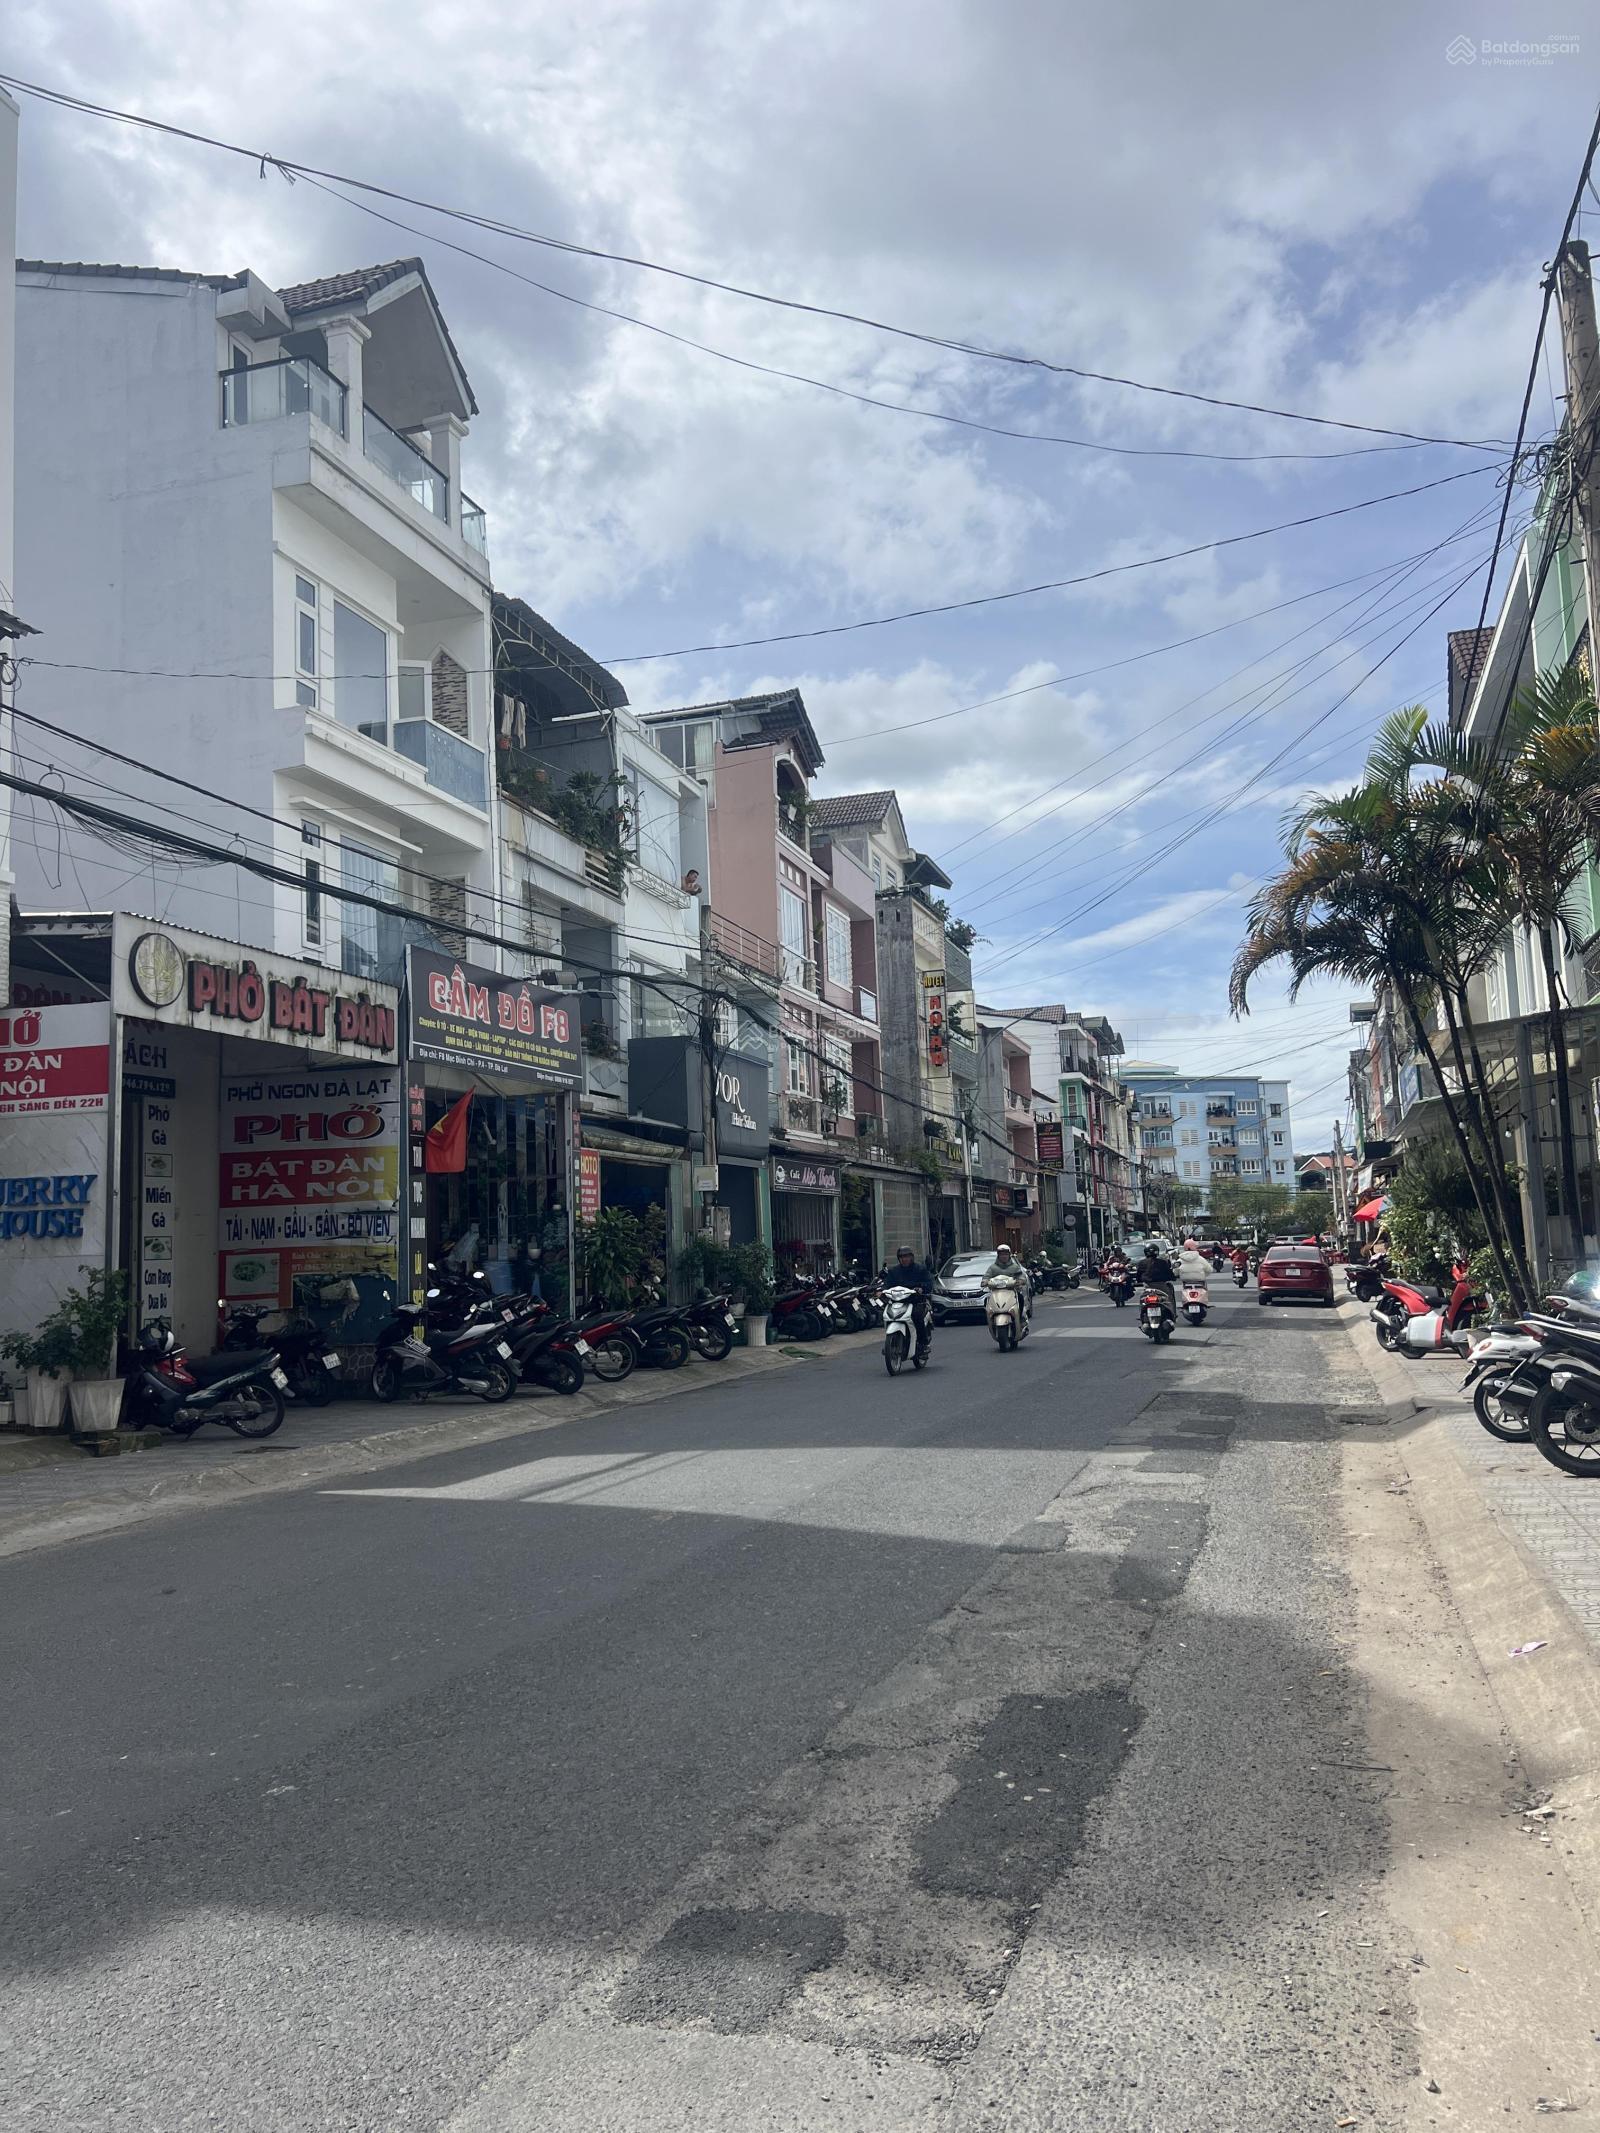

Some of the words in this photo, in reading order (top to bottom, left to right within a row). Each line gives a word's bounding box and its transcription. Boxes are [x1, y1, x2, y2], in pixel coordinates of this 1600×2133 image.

[923, 975, 944, 988] HOTEL
[188, 960, 265, 1022] PHỞ
[269, 976, 330, 1037] BÁT
[334, 992, 395, 1050] ĐÀN
[428, 963, 491, 1025] CẦM
[497, 984, 534, 1035] ĐỒ
[540, 1005, 569, 1043] F8
[450, 1024, 455, 1033] XE
[3, 1051, 62, 1072] ĐÀN
[0, 1075, 46, 1098] NỘI
[227, 1081, 263, 1102] PHỞ
[268, 1083, 319, 1099] NGON
[324, 1078, 350, 1097] ĐÀ
[357, 1079, 391, 1098] LẠT
[53, 1097, 76, 1109] ĐẾN
[80, 1098, 104, 1108] 22H
[233, 1103, 385, 1144] PHỞ
[232, 1156, 304, 1178] BÁT
[310, 1154, 385, 1175] ĐÀN
[231, 1179, 296, 1201] HÀ
[306, 1176, 385, 1198] NỘI
[251, 1217, 275, 1245] NẠM
